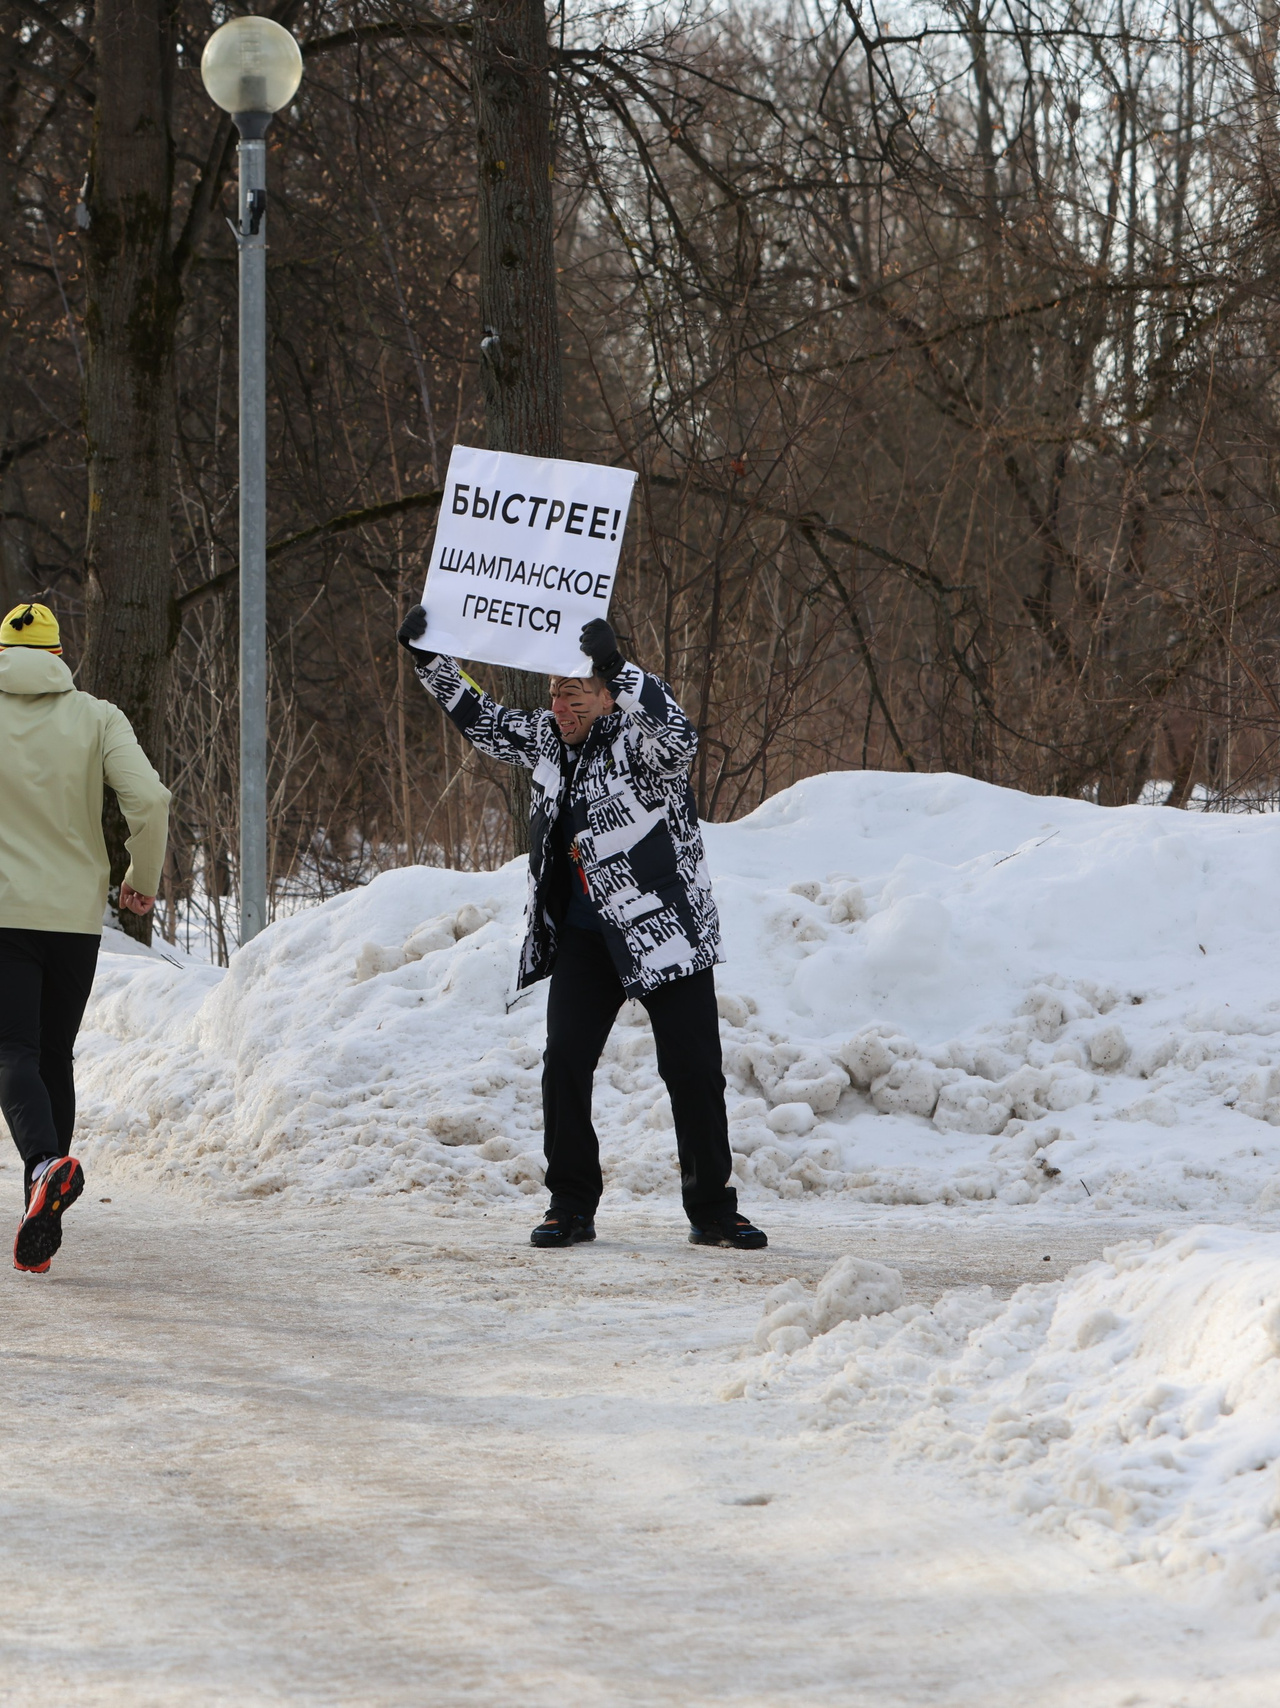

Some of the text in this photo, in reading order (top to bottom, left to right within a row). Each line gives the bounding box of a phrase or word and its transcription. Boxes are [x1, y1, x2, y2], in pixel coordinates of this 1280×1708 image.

[452, 483, 621, 542] БЫСТРЕЕ!
[439, 546, 612, 600] ШАМПАНСКОЕ
[462, 593, 561, 634] ГРЕЕТСЯ
[591, 790, 625, 810] SNOWBOARDING
